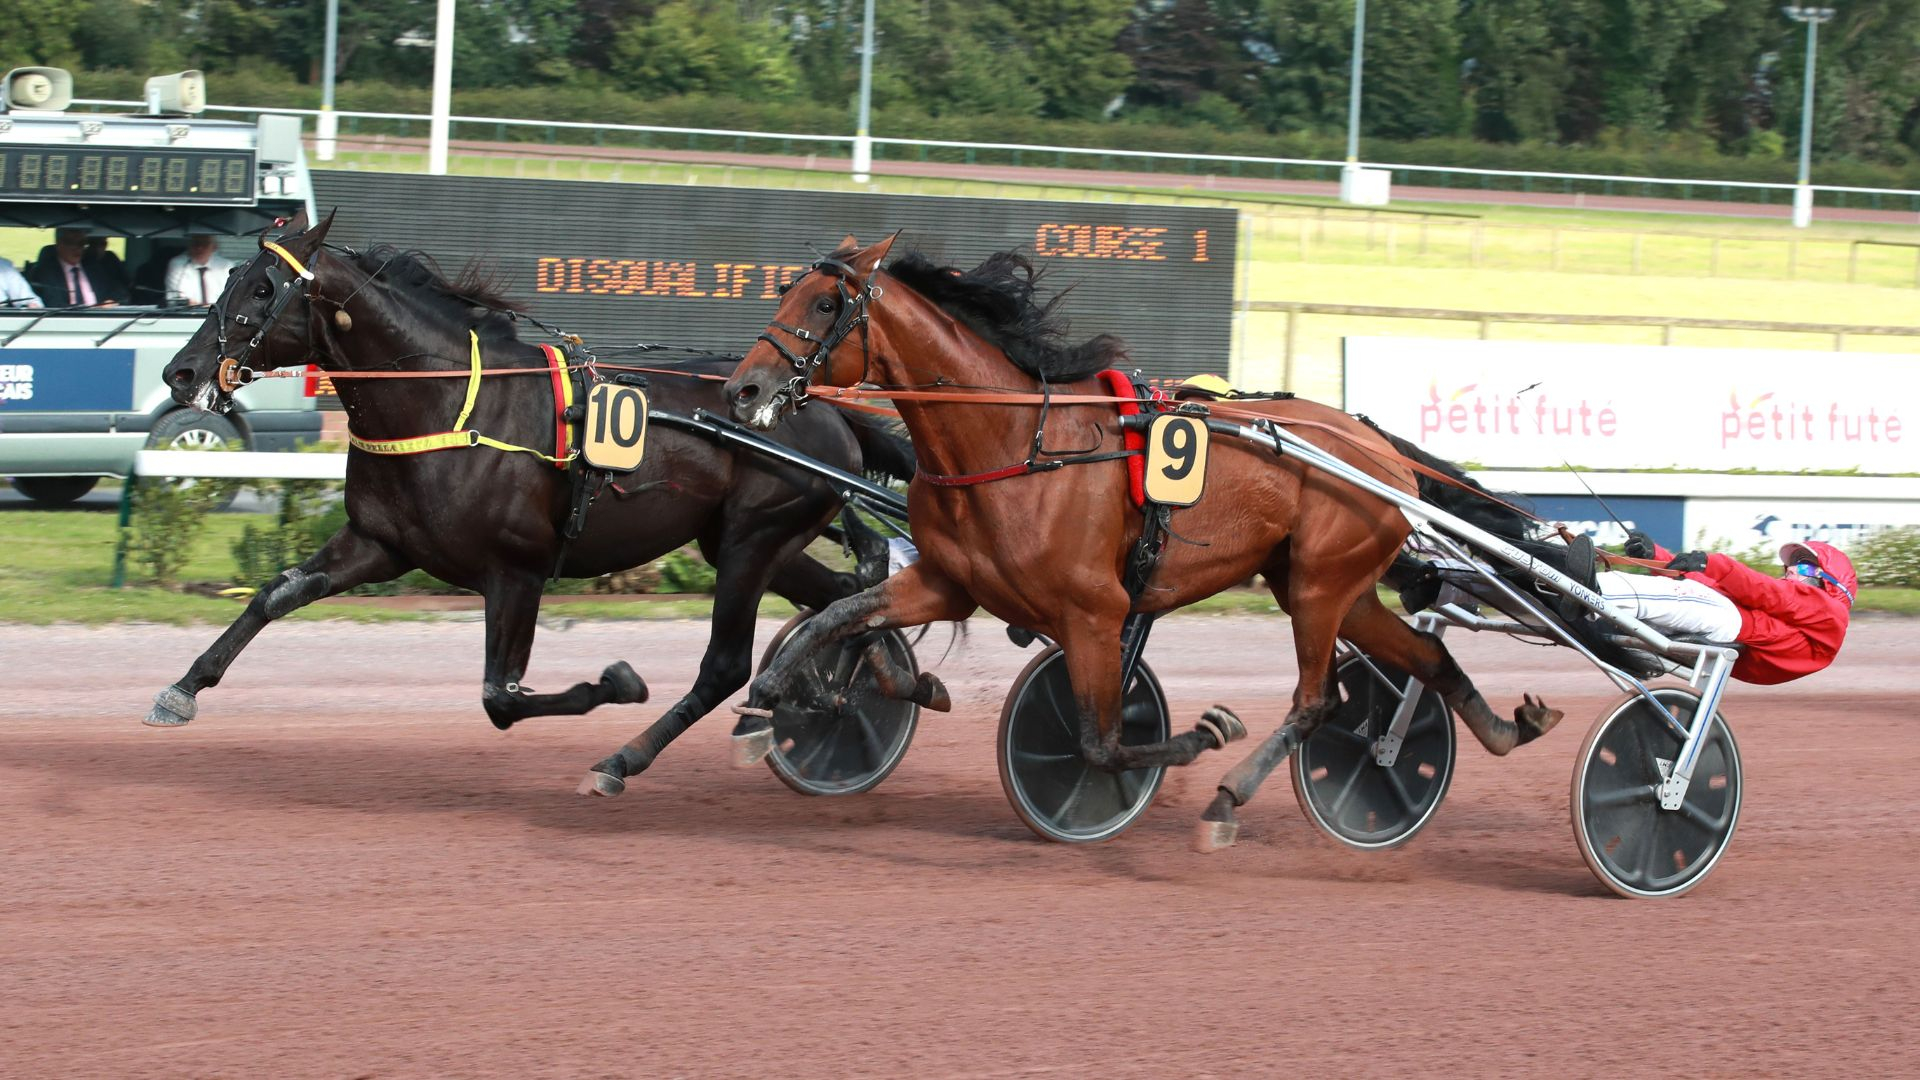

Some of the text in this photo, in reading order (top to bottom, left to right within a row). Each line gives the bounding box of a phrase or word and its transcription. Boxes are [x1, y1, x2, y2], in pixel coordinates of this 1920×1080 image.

[1036, 224, 1209, 263] COURSE 1
[592, 385, 644, 448] 10
[1420, 392, 1520, 444] petit
[1721, 400, 1814, 450] petit
[1161, 418, 1197, 480] 9
[1569, 581, 1605, 610] YONKERS
